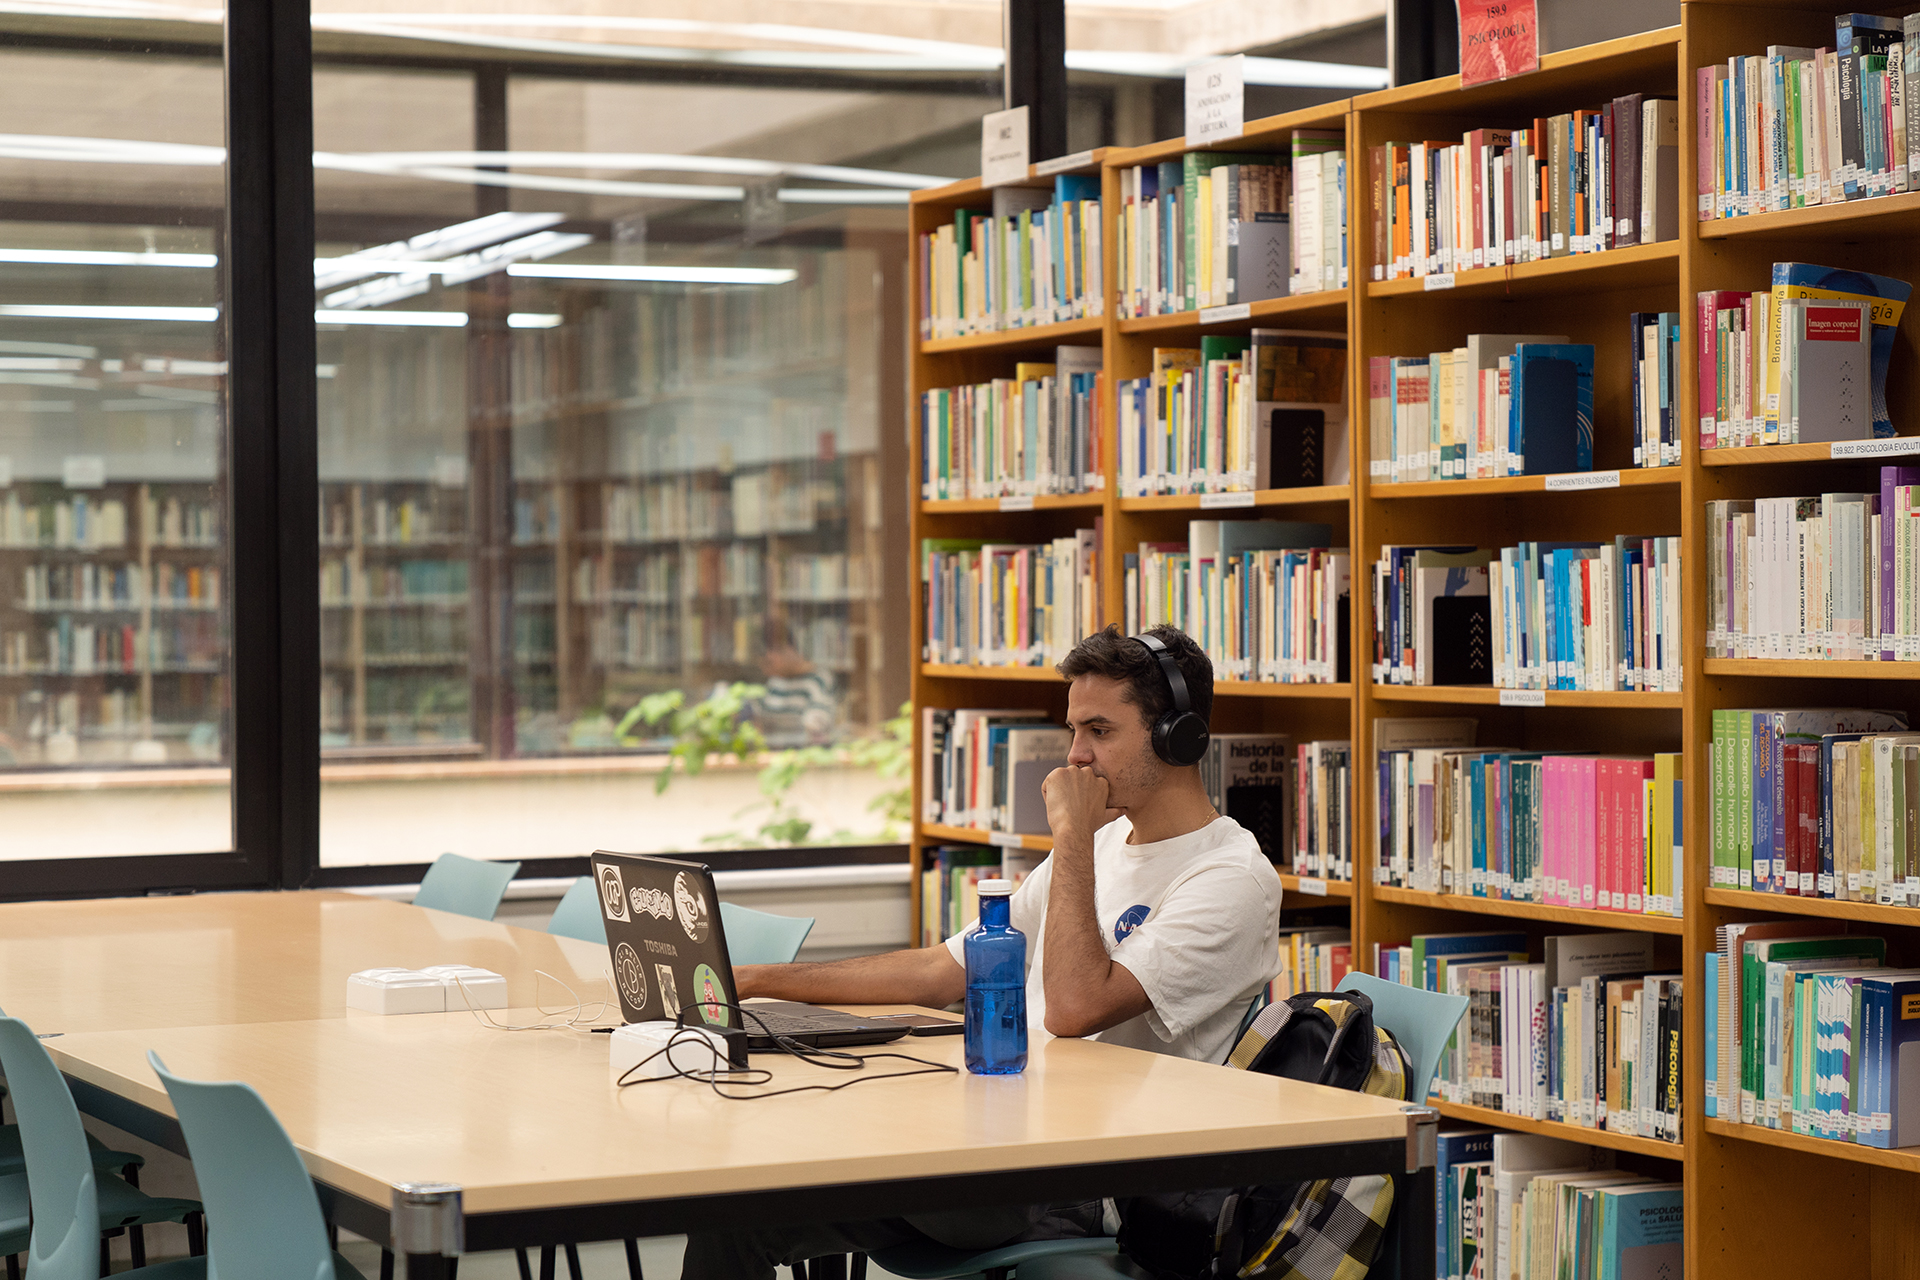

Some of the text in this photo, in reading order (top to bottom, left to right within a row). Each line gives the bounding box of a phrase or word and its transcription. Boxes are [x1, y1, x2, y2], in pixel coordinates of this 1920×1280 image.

[1486, 4, 1507, 19] 159.9
[1840, 58, 1852, 100] Psicología
[1808, 318, 1859, 330] Imagen corporal
[1832, 446, 1855, 455] 159.922
[1856, 443, 1894, 453] PSICOLOGIA
[1230, 742, 1284, 758] historia
[1249, 758, 1284, 774] de la
[1775, 740, 1784, 816] Psicología del desarrollo
[1715, 737, 1724, 849] Desarrollo humano
[1727, 738, 1736, 850] Desarrollo humano
[1741, 738, 1750, 851] Desarrollo humano
[643, 939, 679, 957] TOSHIBA
[1463, 1197, 1472, 1239] TEST
